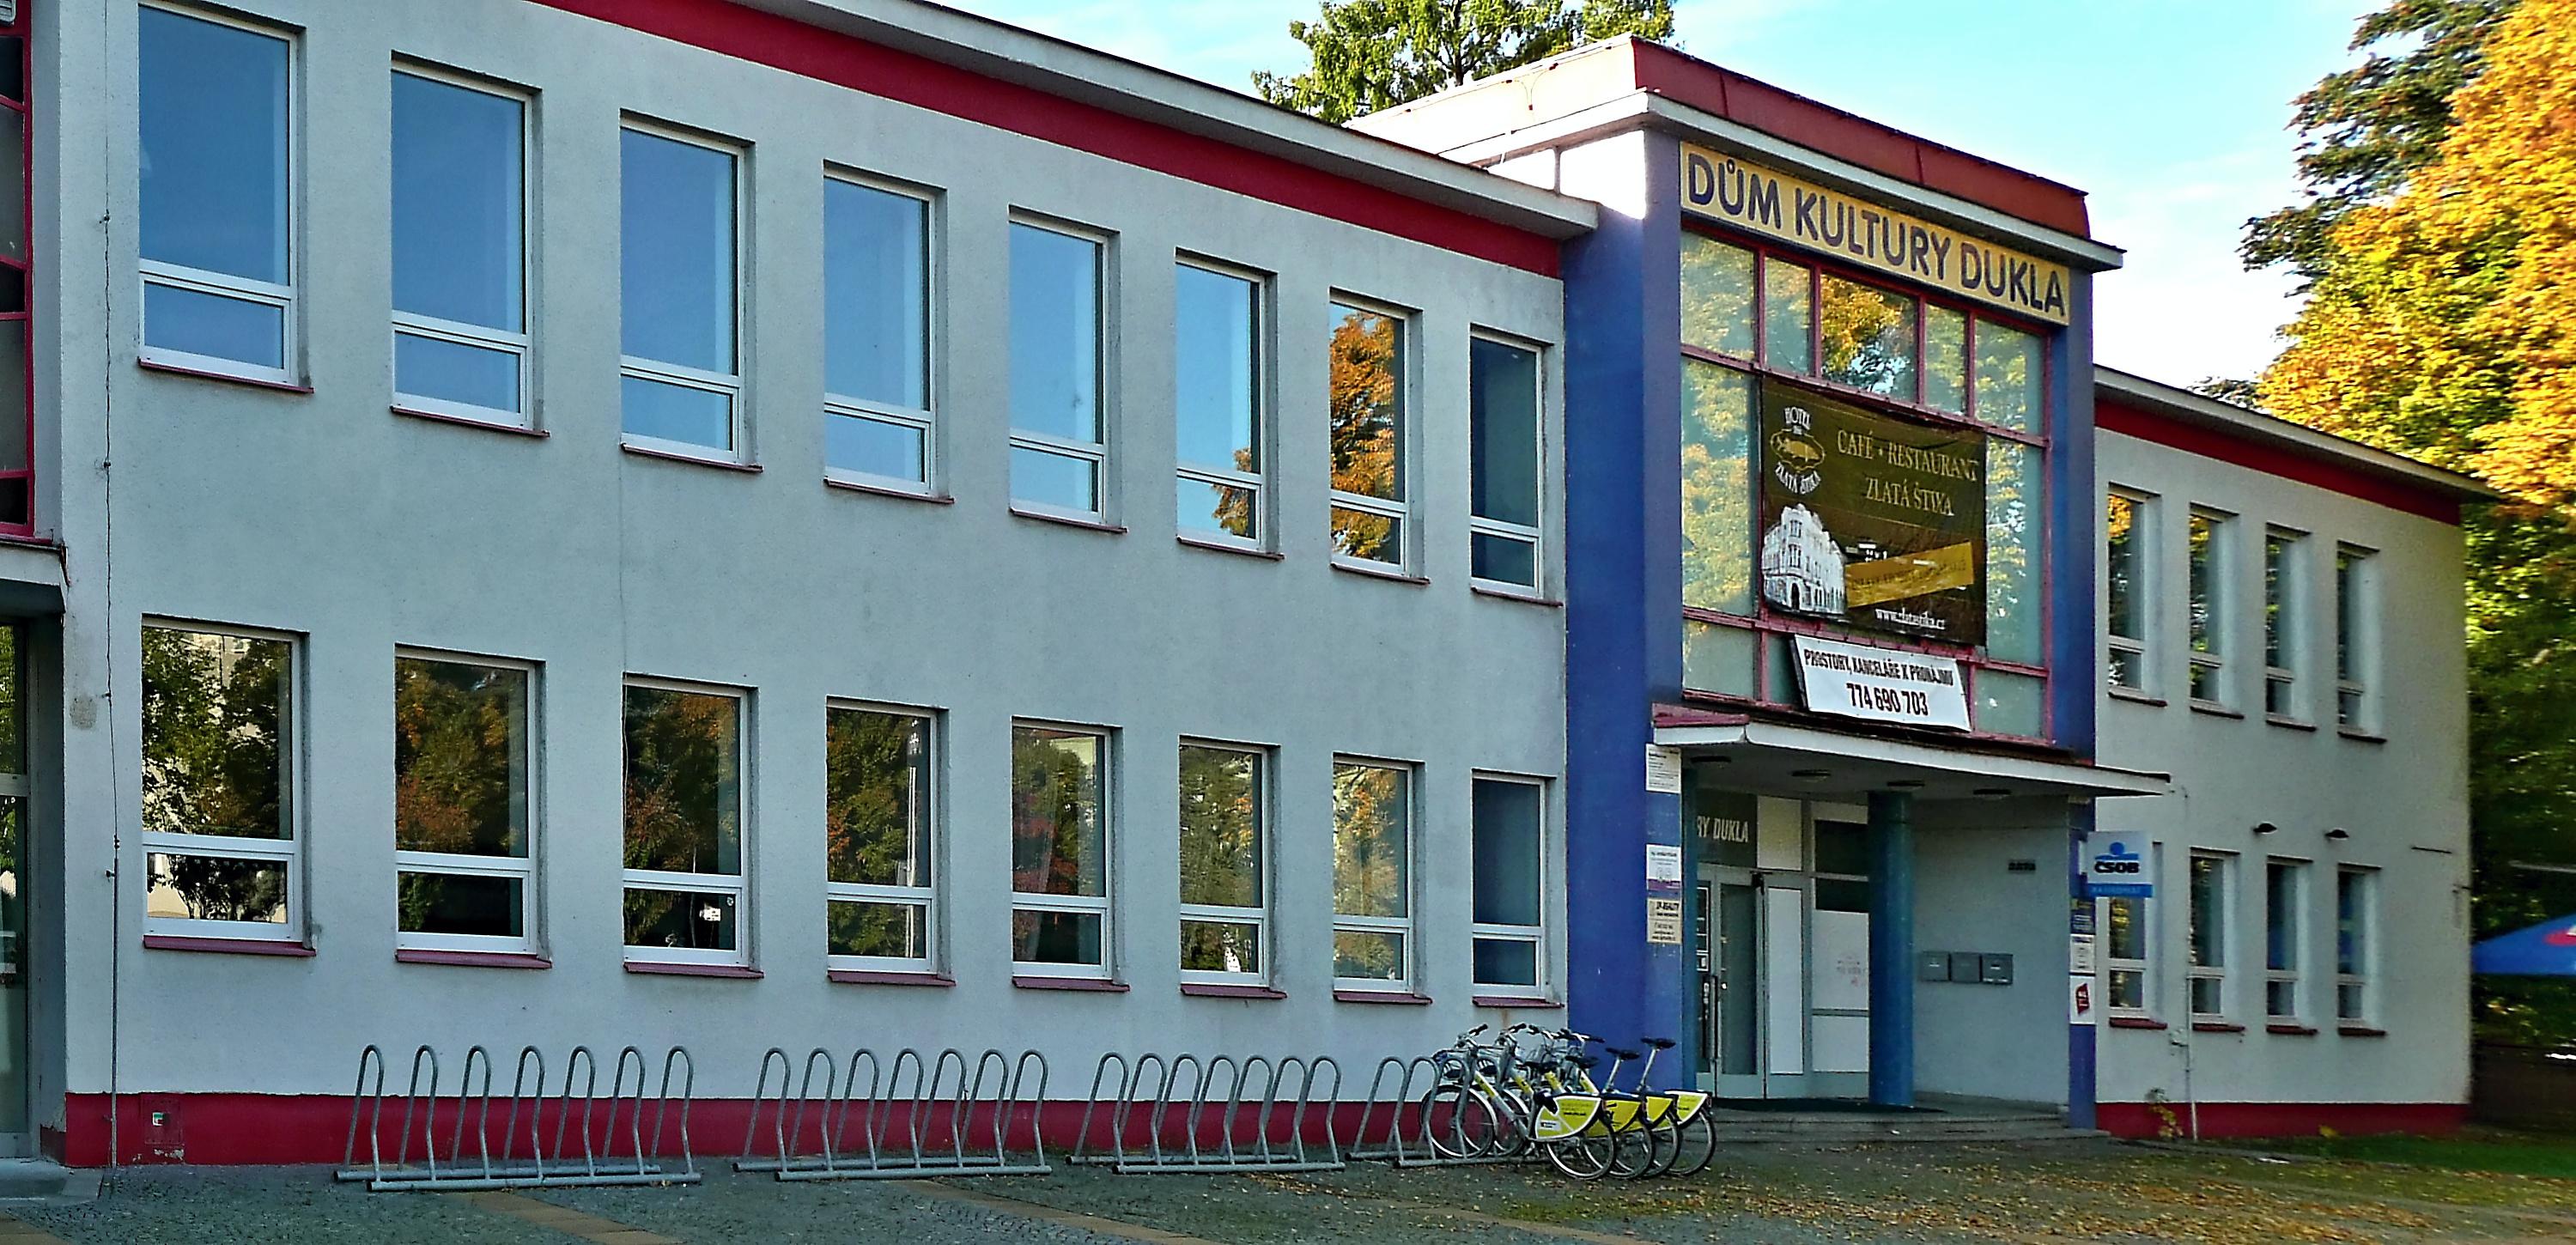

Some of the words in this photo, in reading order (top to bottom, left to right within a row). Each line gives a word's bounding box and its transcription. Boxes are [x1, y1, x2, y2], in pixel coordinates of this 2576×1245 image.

[1687, 153, 1781, 229] DŮM
[1795, 187, 1952, 280] KULTURY
[1960, 241, 2066, 317] DUKLA
[1837, 429, 1874, 459] CAFÉ
[1888, 441, 1979, 481] RESTAURANT
[1864, 477, 1911, 508] ZLATÁ
[1902, 663, 1910, 680] K
[1846, 683, 1873, 709] 774
[1874, 686, 1902, 714] 690
[1901, 689, 1929, 716] 703
[1713, 817, 1749, 843] DUKLA
